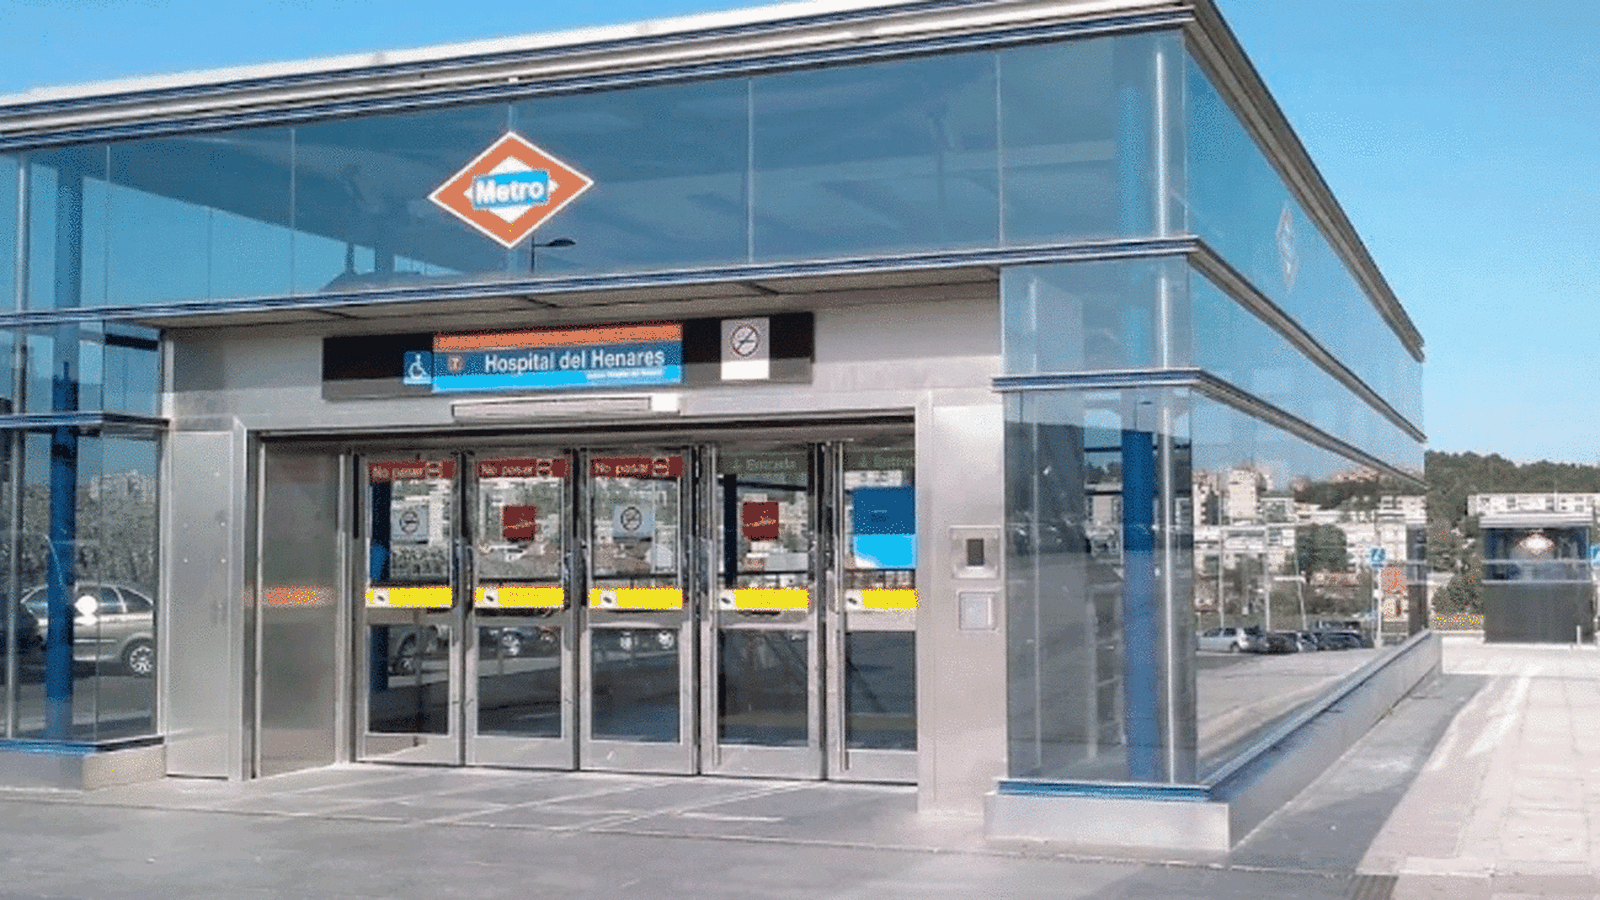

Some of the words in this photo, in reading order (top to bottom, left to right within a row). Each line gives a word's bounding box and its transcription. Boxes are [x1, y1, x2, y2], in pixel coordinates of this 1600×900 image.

[476, 179, 545, 204] Metro
[485, 352, 555, 377] Hospital
[559, 351, 586, 369] del
[592, 349, 665, 368] Henares
[482, 464, 498, 474] No
[502, 465, 533, 476] pasar
[596, 463, 612, 473] No
[616, 463, 649, 477] pasar
